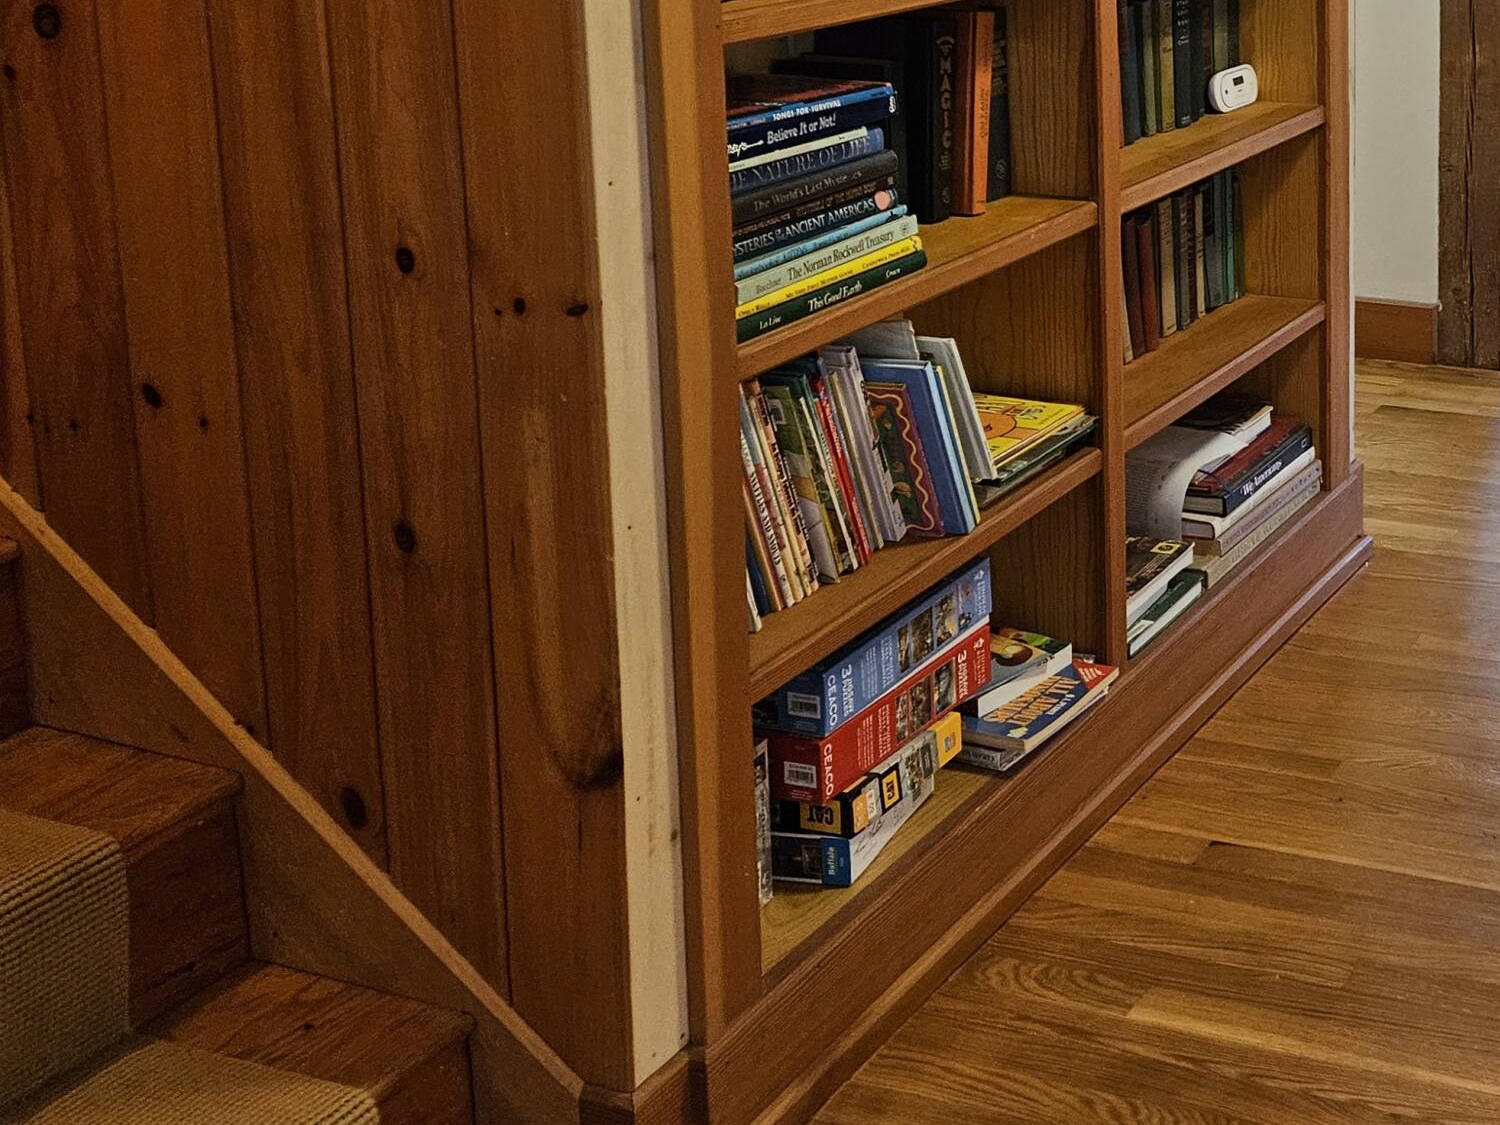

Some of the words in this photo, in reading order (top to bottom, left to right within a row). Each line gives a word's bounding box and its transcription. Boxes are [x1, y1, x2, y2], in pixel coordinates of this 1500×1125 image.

[811, 99, 842, 113] SURVIVAL
[766, 126, 799, 145] Believe
[799, 121, 808, 135] It
[808, 121, 819, 132] or
[818, 112, 837, 131] Not!
[751, 152, 816, 181] NATURE
[819, 145, 836, 165] OF
[842, 135, 871, 158] LIFE
[753, 199, 770, 212] The
[771, 187, 804, 206] World's
[805, 180, 823, 195] Last
[733, 232, 775, 256] YSTERIES
[785, 214, 826, 239] ANCIENT
[828, 198, 875, 223] AMERICAS
[786, 265, 803, 282] The
[803, 254, 833, 275] Norman
[833, 241, 865, 265] Rockwell
[865, 229, 895, 252] Treasury
[807, 298, 824, 312] This
[823, 289, 843, 306] Good
[842, 280, 863, 301] Earth
[762, 515, 772, 533] AND
[767, 532, 781, 566] SNOUTS
[841, 664, 852, 679] 3
[957, 649, 967, 663] 3
[827, 674, 838, 726] CEACO
[823, 743, 834, 795] CEACO
[886, 779, 895, 800] CAT
[807, 804, 834, 825] CAT
